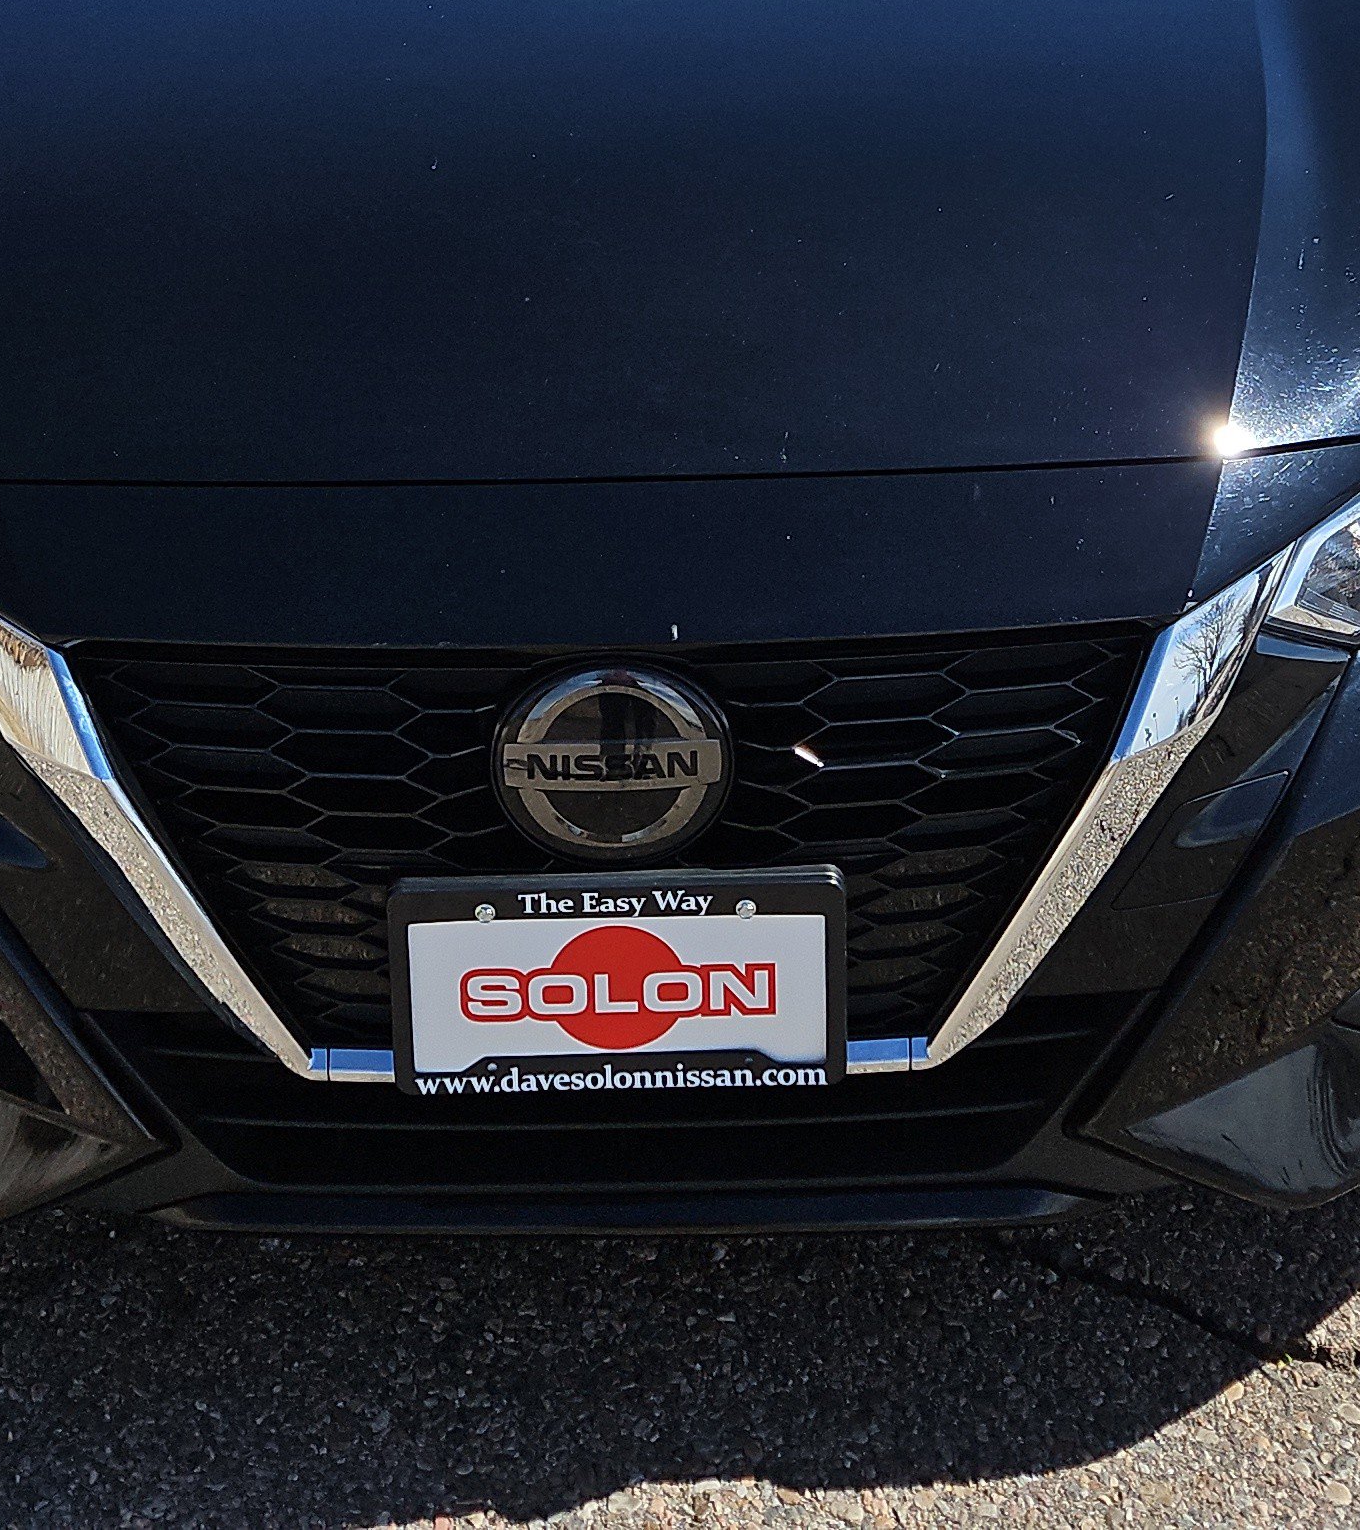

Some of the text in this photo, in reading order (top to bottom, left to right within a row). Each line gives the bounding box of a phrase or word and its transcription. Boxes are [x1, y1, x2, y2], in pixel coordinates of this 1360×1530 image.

[526, 750, 698, 781] NISSAN
[518, 890, 713, 917] The Easy Way
[460, 963, 777, 1022] SOLON
[415, 1063, 828, 1095] www.davesolonnissan.com
